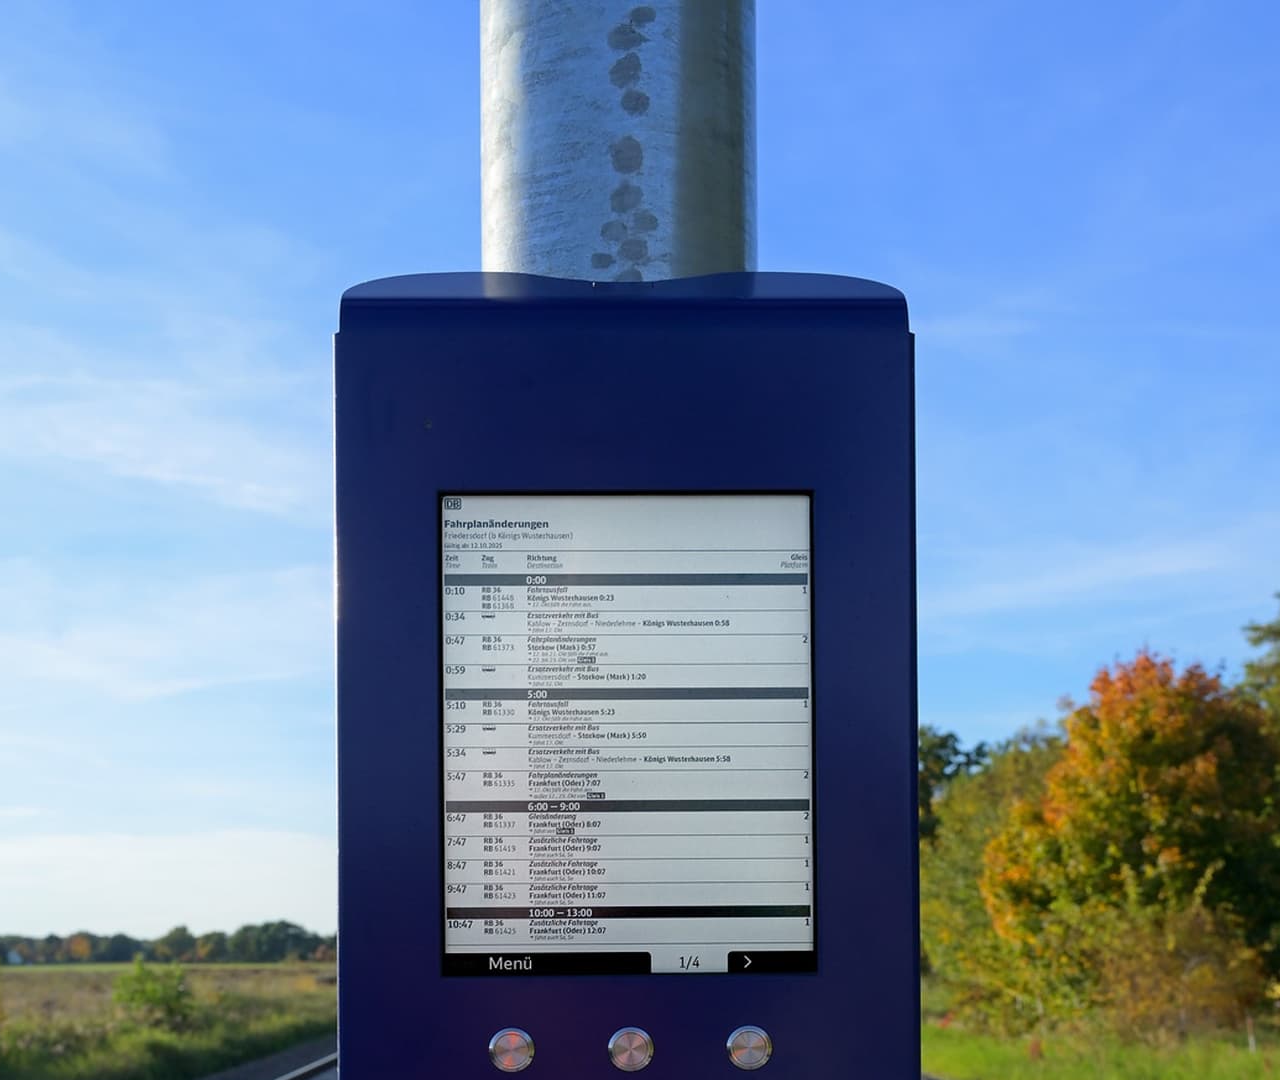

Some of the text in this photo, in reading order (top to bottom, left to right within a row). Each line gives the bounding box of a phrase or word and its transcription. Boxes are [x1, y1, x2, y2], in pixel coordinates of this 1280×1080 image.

[446, 499, 460, 510] DB
[444, 520, 549, 530] Fahrplanänderungen
[444, 532, 487, 540] Friedersdorf
[498, 532, 520, 540] Königs
[522, 532, 573, 540] Wusterhausen)
[526, 576, 546, 584] 0:00
[445, 587, 465, 596] 0:10
[527, 594, 549, 602] Königs
[445, 612, 465, 621] 0:34
[445, 636, 465, 644] 0:47
[527, 636, 596, 644] Fahrplanänderungen
[446, 666, 465, 674] 0:59
[528, 690, 547, 698] 5:00
[446, 702, 466, 710] 5:10
[528, 709, 550, 717] Königs
[447, 725, 466, 733] 5:29
[447, 749, 466, 757] 5:34
[447, 772, 466, 781] 5:47
[528, 772, 598, 780] Fahrplanänderungen
[528, 802, 580, 811] 6:00 9:00
[447, 814, 466, 822] 6:47
[447, 838, 466, 846] 7:47
[529, 837, 598, 845] Zusätzliche Fahrtage
[529, 868, 606, 876] Frankfurt (Oder) 10:07
[447, 885, 467, 893] 9:47
[529, 884, 598, 892] Zusätzliche Fahrtage
[529, 909, 592, 917] 10:00 13:00
[448, 920, 473, 928] 10:47
[530, 927, 606, 935] Frankfurt (Oder) 12:07
[489, 957, 532, 970] Menü
[679, 956, 700, 970] 1/4
